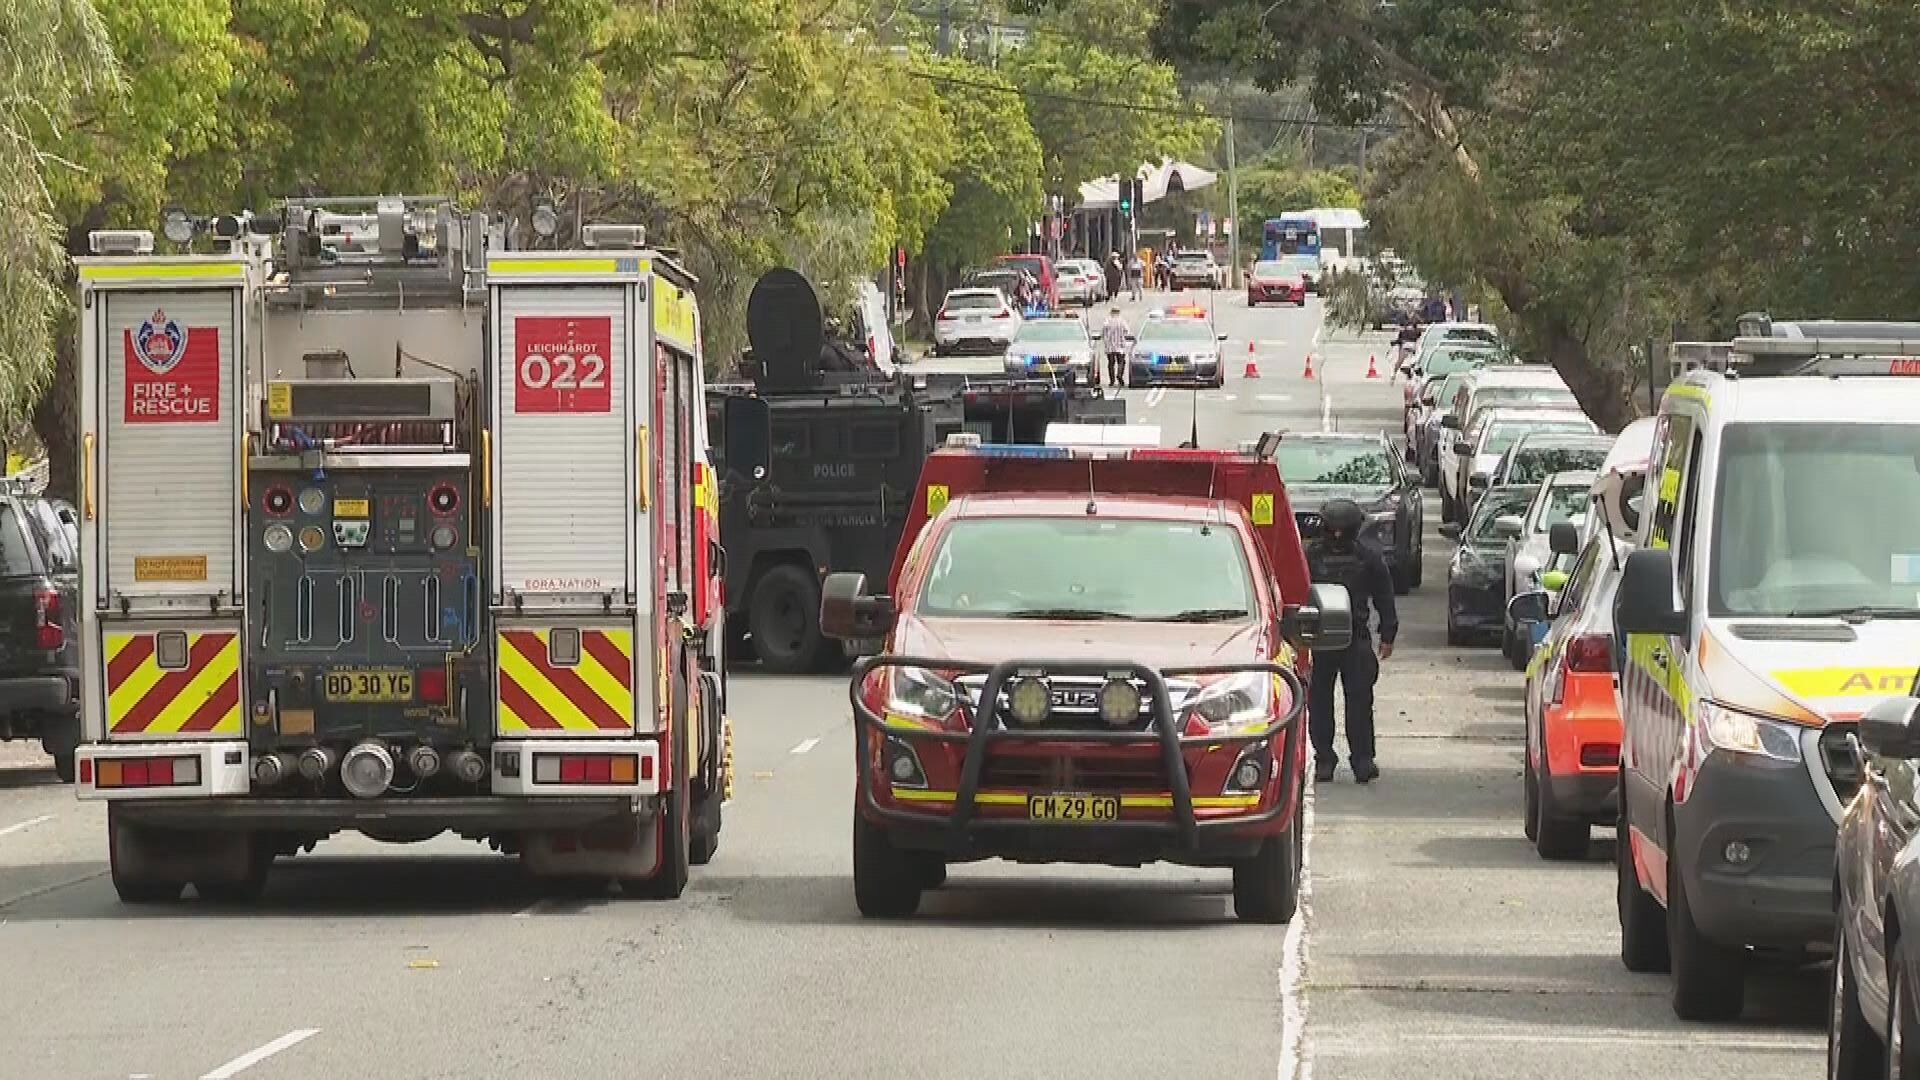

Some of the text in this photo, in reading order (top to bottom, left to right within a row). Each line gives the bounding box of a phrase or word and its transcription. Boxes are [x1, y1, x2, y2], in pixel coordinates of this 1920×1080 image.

[527, 343, 598, 353] LEICHHARDT
[521, 353, 605, 389] 022
[133, 382, 177, 398] FIRE
[133, 398, 211, 415] RESCUE
[813, 463, 856, 478] POLICE
[559, 579, 601, 589] NATION
[1839, 671, 1914, 692] Am
